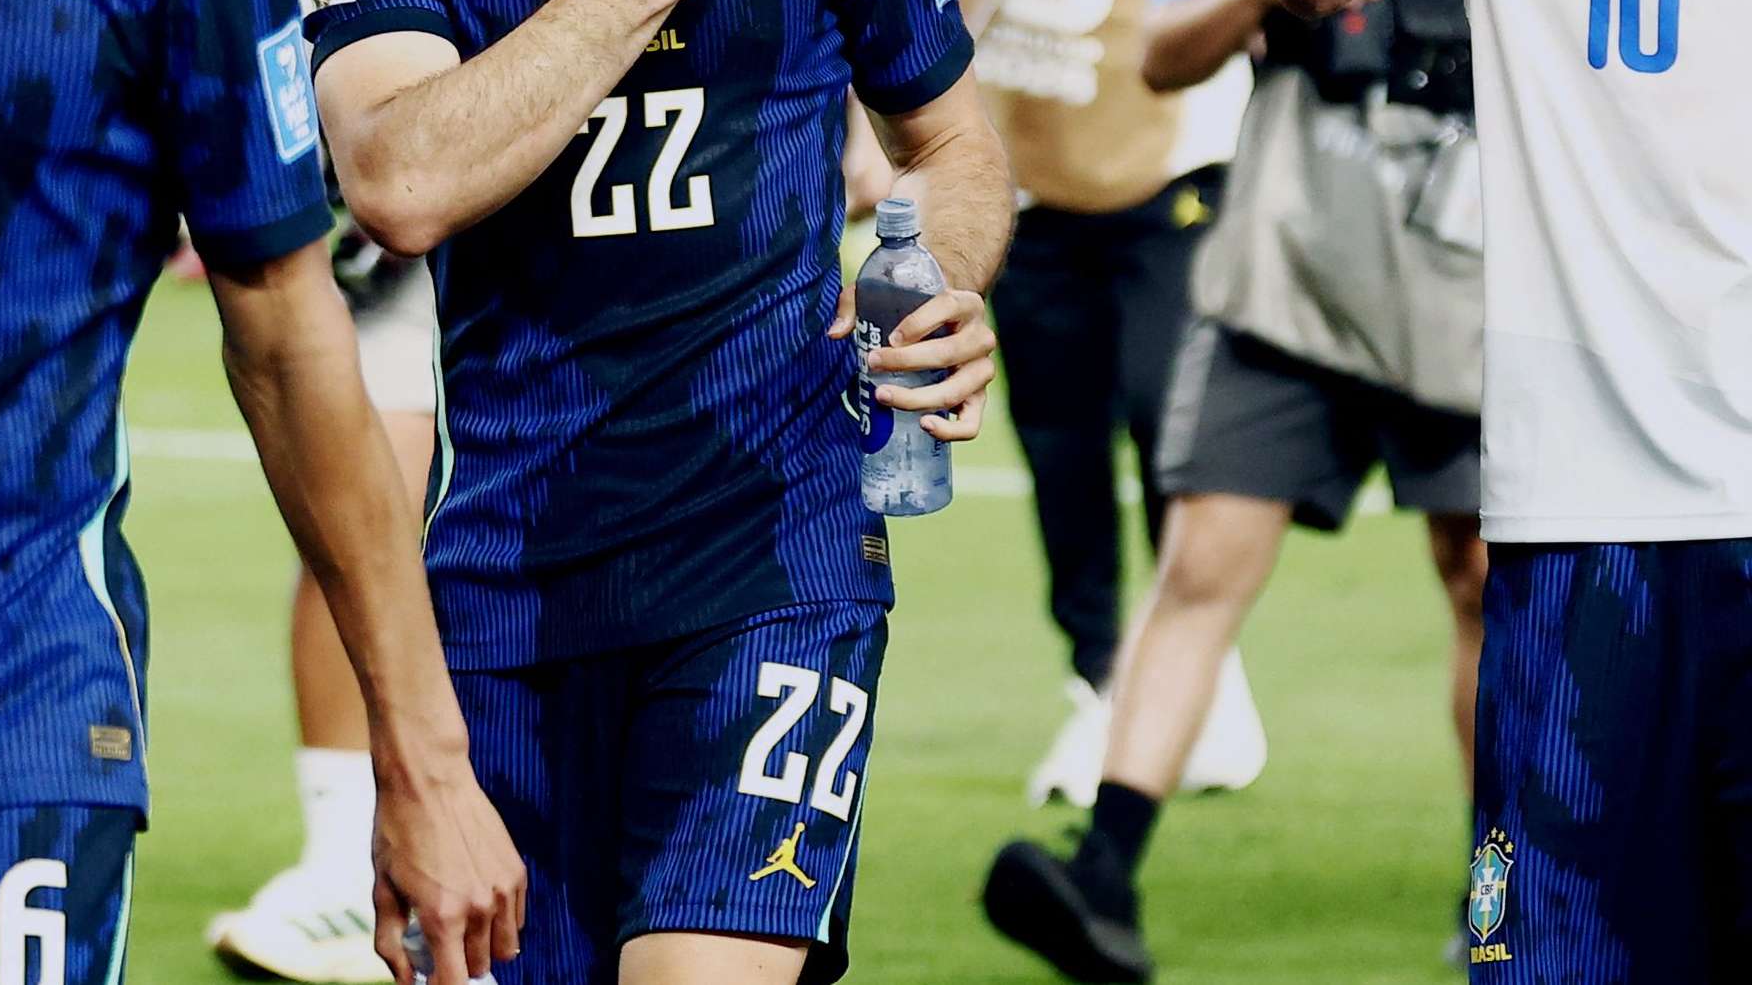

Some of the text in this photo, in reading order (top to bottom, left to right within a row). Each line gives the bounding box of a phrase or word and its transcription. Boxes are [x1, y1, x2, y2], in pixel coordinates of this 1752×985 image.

[571, 87, 715, 238] 22
[738, 661, 868, 822] 22
[1480, 883, 1495, 897] CBF
